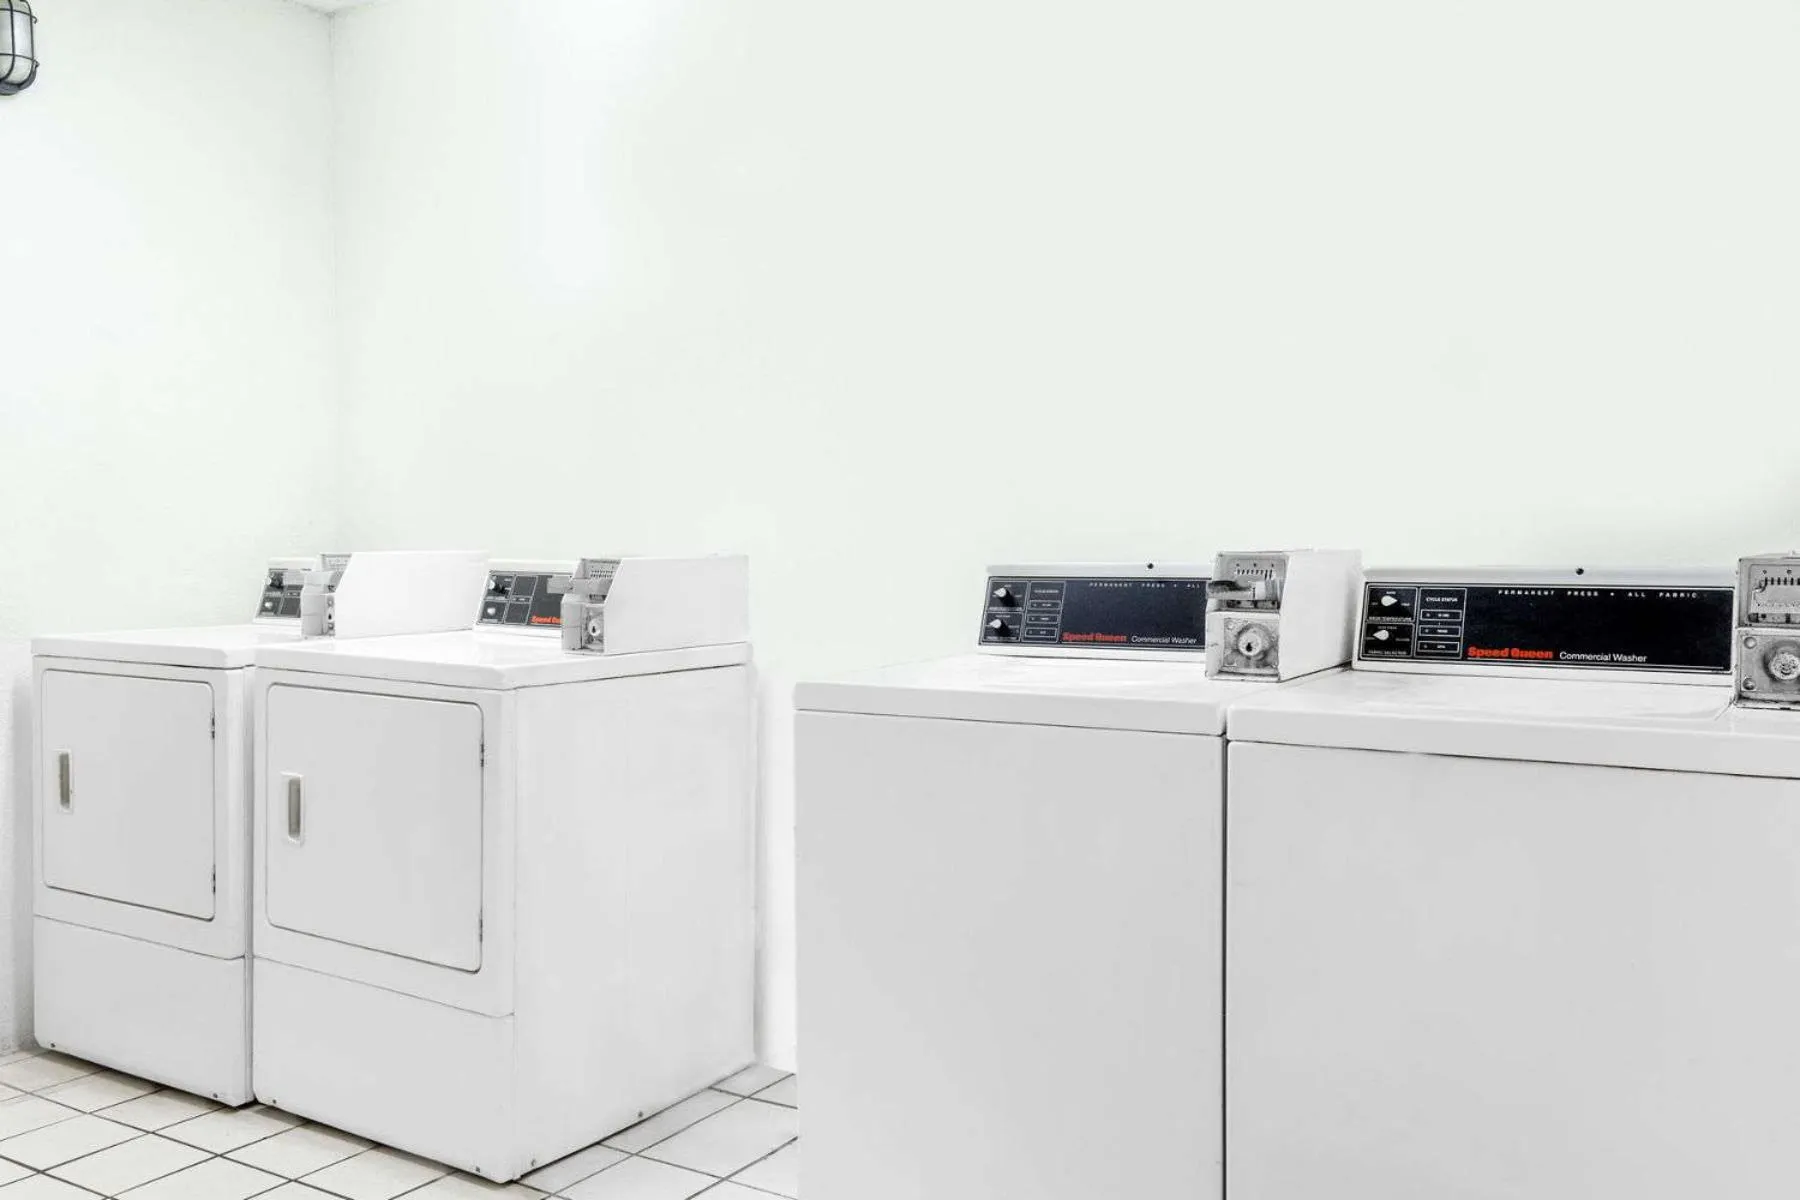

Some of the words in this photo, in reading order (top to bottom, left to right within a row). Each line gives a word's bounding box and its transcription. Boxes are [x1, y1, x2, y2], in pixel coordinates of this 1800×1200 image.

[1062, 631, 1095, 642] Speed
[1095, 632, 1128, 642] Queen
[1131, 635, 1171, 643] Commercial
[1171, 636, 1198, 644] Washer
[1467, 646, 1509, 658] Speed
[1510, 647, 1553, 659] Queen
[1559, 651, 1611, 662] Commercial
[1612, 653, 1648, 663] Washer
